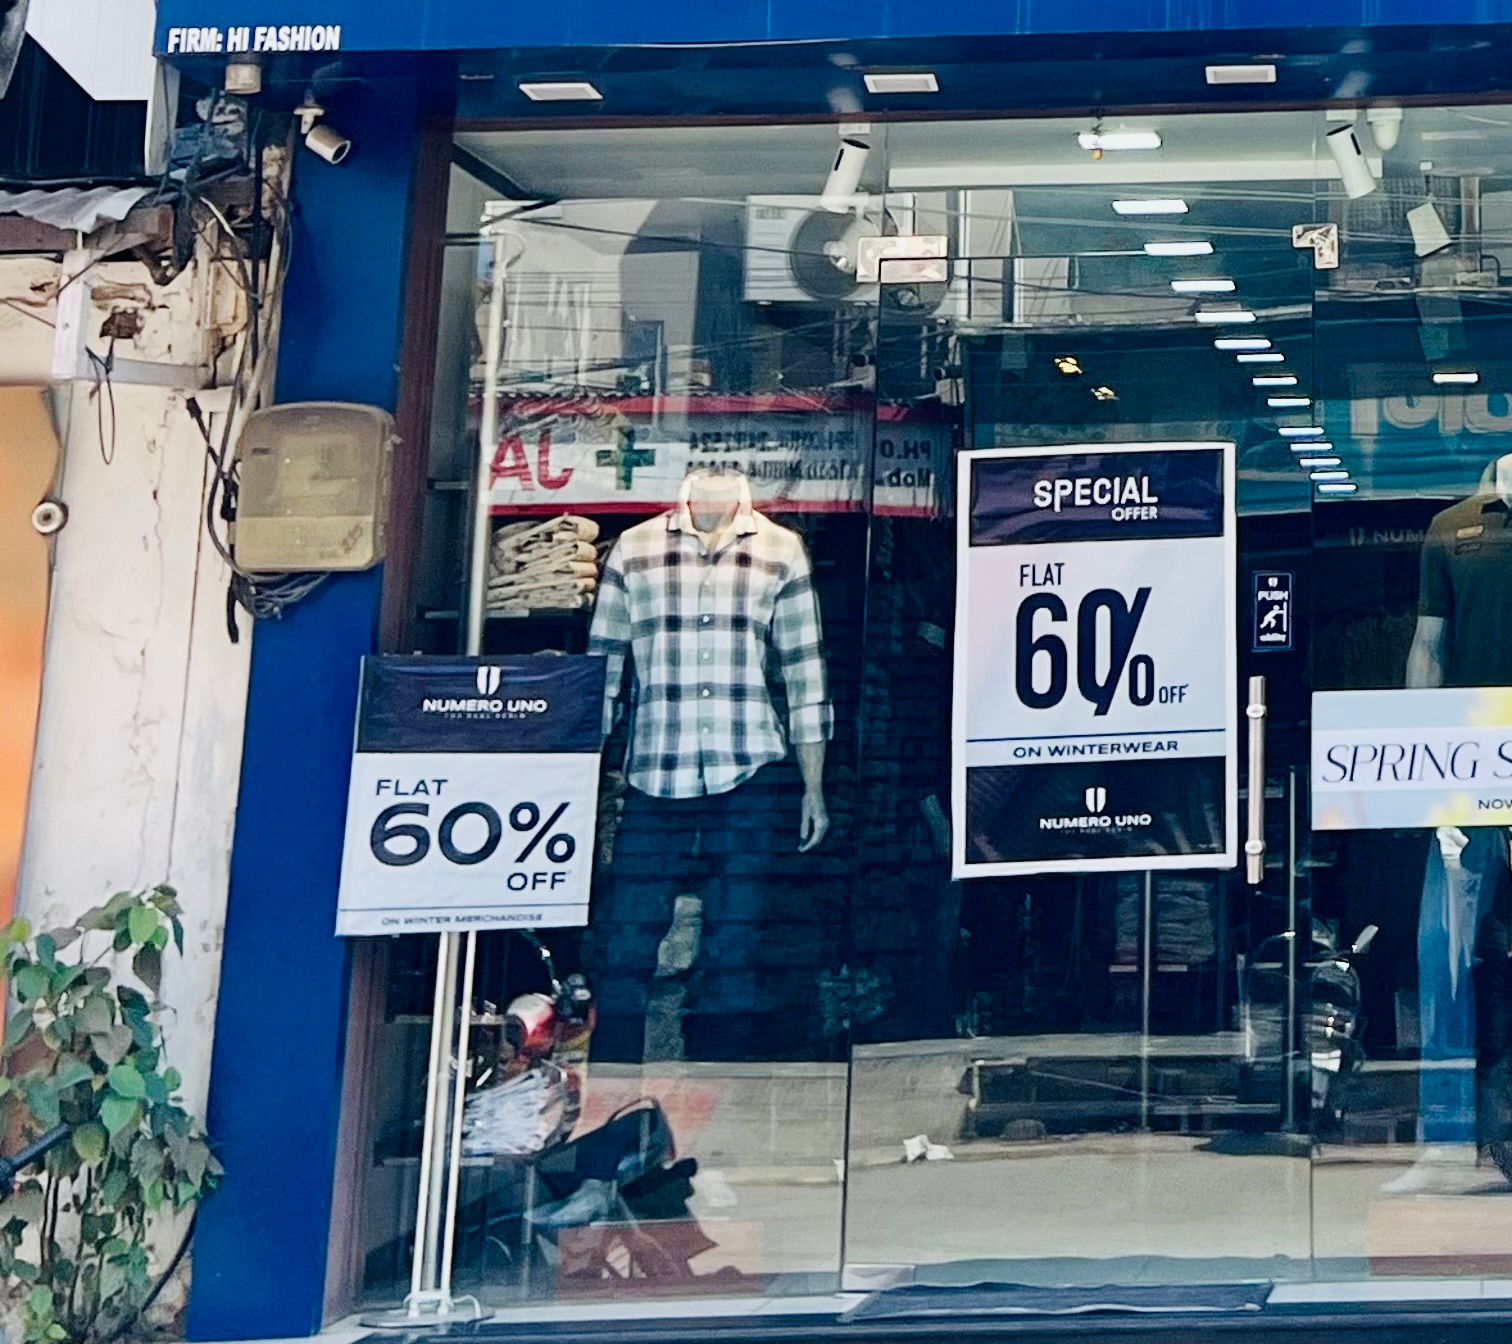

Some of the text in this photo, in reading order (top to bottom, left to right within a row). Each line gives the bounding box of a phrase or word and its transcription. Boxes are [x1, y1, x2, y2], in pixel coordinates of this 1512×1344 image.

[167, 25, 341, 53] FIRM: HI FASHION
[1033, 477, 1158, 512] SPECIAL
[1112, 506, 1158, 522] OFFER
[1020, 563, 1065, 587] FLAT
[1016, 587, 1155, 716] 60%
[1159, 684, 1189, 704] OFF
[422, 698, 548, 713] NUMERO UNO
[1013, 741, 1179, 759] ON WINTERWEAR
[1321, 742, 1480, 783] SPRING
[376, 779, 448, 796] FLAT
[1039, 815, 1112, 830] NUMERO
[1114, 813, 1153, 827] UNO
[370, 801, 576, 867] 60%
[507, 871, 567, 891] OFF
[382, 913, 543, 926] ON WINTER MERCHANDISE
